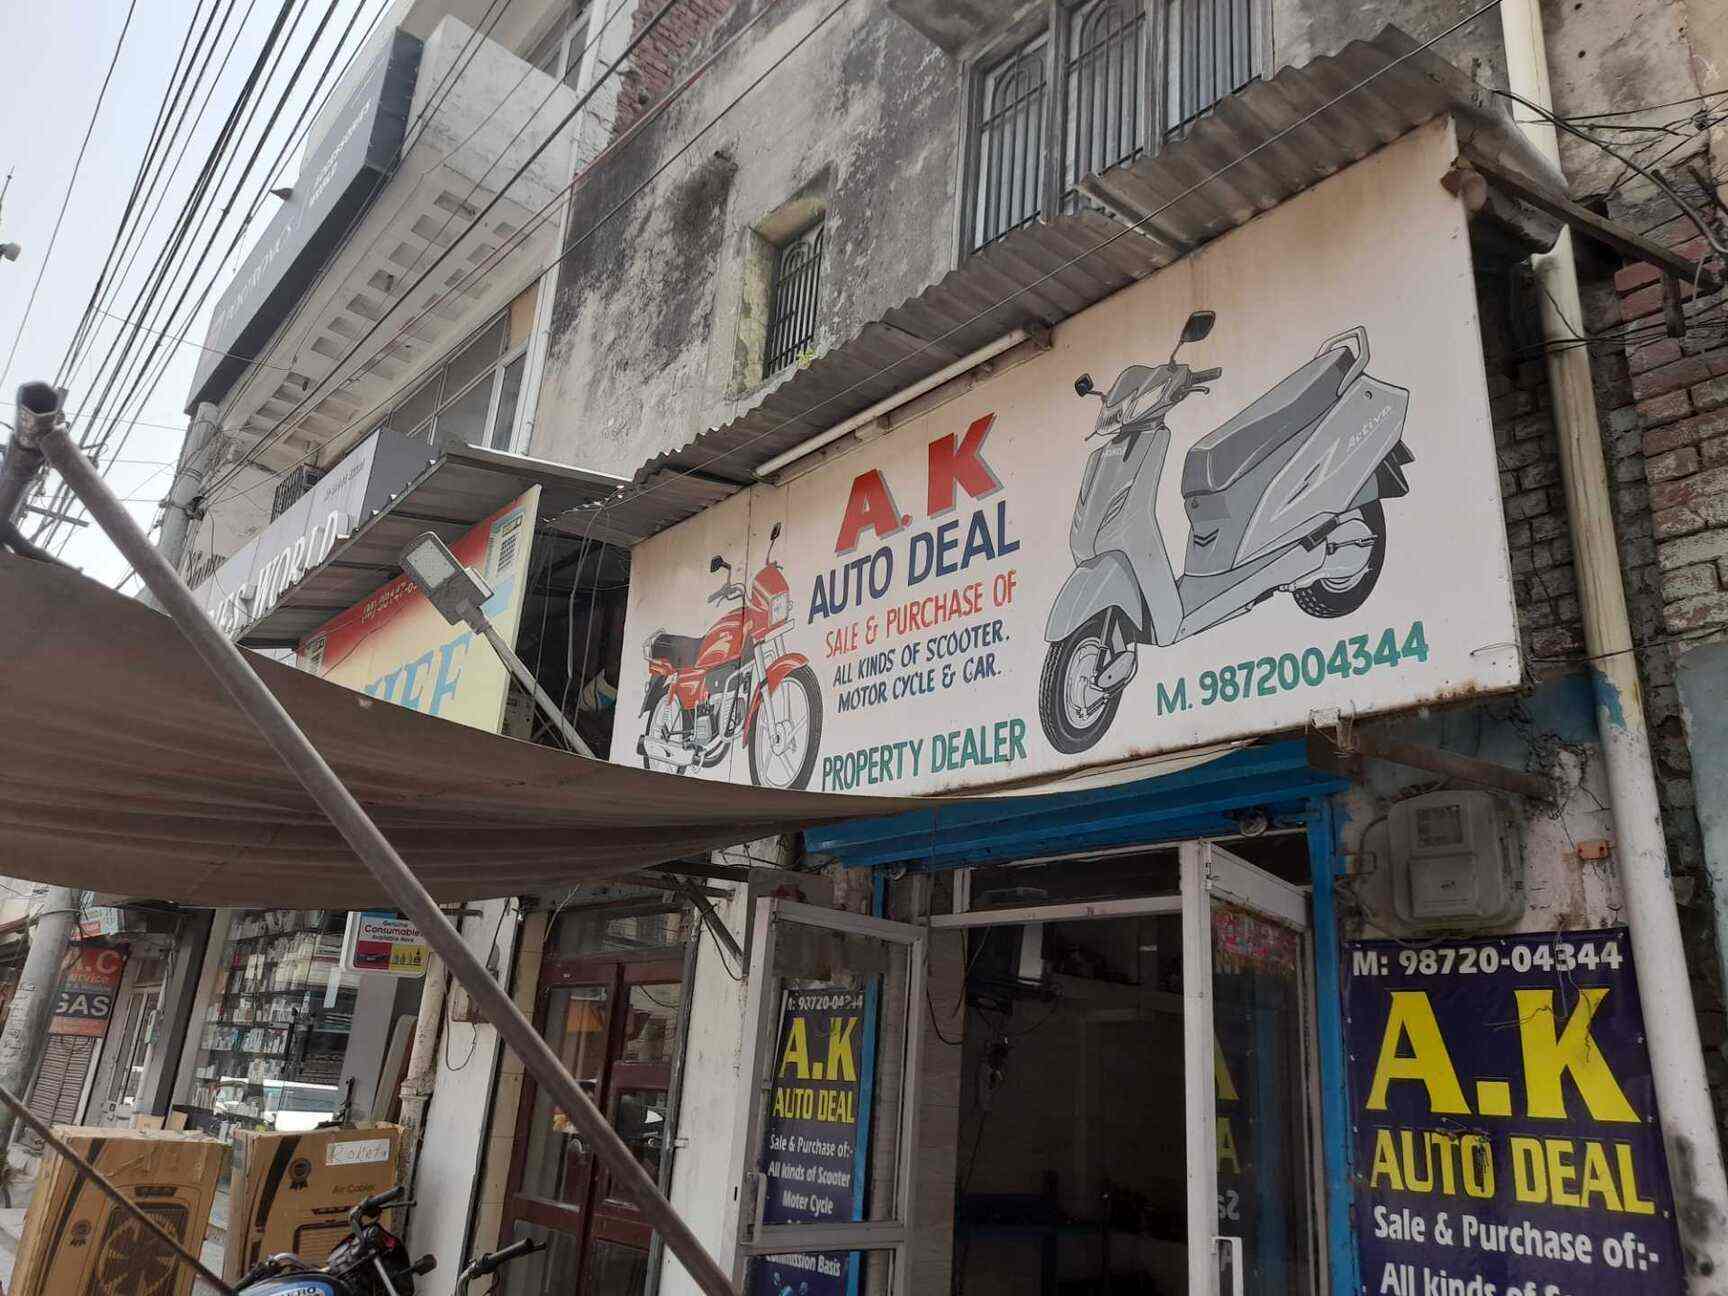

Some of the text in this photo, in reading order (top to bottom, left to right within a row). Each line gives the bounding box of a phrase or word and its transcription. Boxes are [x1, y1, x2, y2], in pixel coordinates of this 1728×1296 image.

[834, 411, 1005, 557] A.K
[807, 500, 1020, 625] AUTO DEAL
[825, 569, 1018, 658] SALE & PURCHASE OF
[833, 618, 1010, 688] ALL KINDS OF SCOOTER.
[838, 654, 1002, 714] MOTOR CYCLE & CAR.
[1155, 620, 1429, 716] M. 9872004344
[821, 718, 1028, 793] PROPERTY DEALER
[1352, 942, 1624, 977] M: 98720-04344
[778, 1017, 858, 1082] A.K
[1365, 988, 1642, 1123] A.K
[772, 1086, 855, 1124] AUTO DEAL
[768, 1160, 850, 1188] All kinds of Scooter
[769, 1134, 787, 1151] Sale
[788, 1136, 796, 1152] &
[797, 1136, 835, 1156] Purchase
[1369, 1129, 1655, 1215] AUTO DEAL
[810, 1194, 834, 1218] Cycle
[1373, 1205, 1659, 1271] Sale & Purchase of:-
[817, 1254, 841, 1278] Basis
[1380, 1262, 1415, 1296] All
